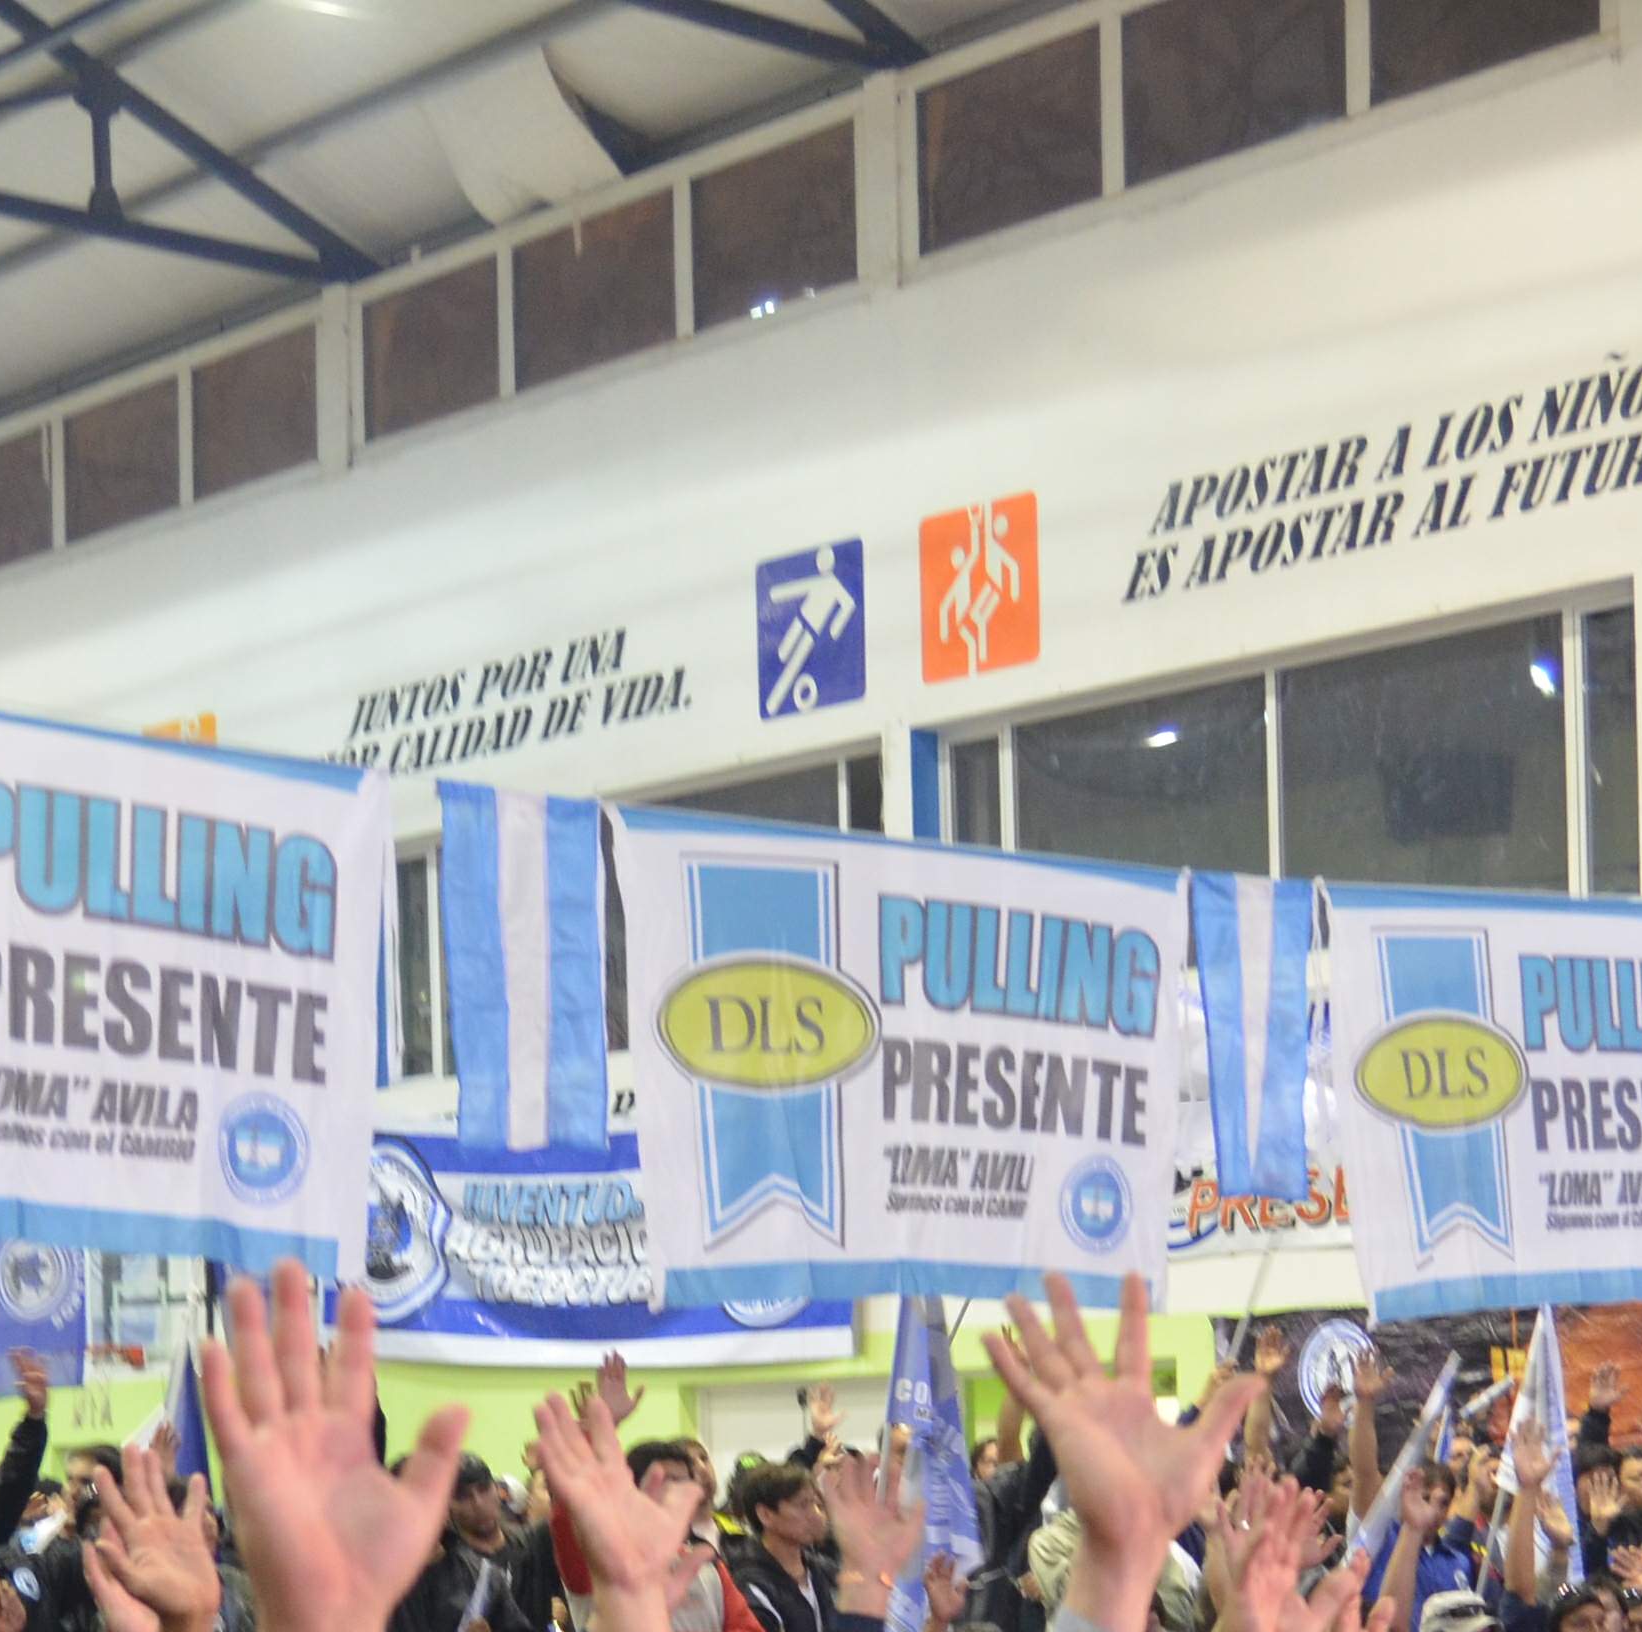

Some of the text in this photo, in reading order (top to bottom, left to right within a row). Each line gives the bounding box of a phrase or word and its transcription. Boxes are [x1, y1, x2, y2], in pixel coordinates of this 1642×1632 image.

[1149, 434, 1369, 537] APOSTAR
[1375, 422, 1413, 482] A
[1423, 393, 1524, 471] LOS
[1122, 545, 1178, 602] ES
[1185, 489, 1404, 590] APOSTAR
[1412, 471, 1478, 538] AL
[349, 627, 626, 741] JUNTOS POR UNA
[389, 704, 535, 776] CALIDAD
[541, 689, 593, 741] DE
[601, 665, 692, 726] VIDA.
[878, 893, 1161, 1039] PULLING
[704, 995, 825, 1056] DLS
[1401, 1048, 1489, 1099] DLS
[91, 1078, 199, 1133] AVILA
[881, 1036, 1149, 1147] PRESENTE
